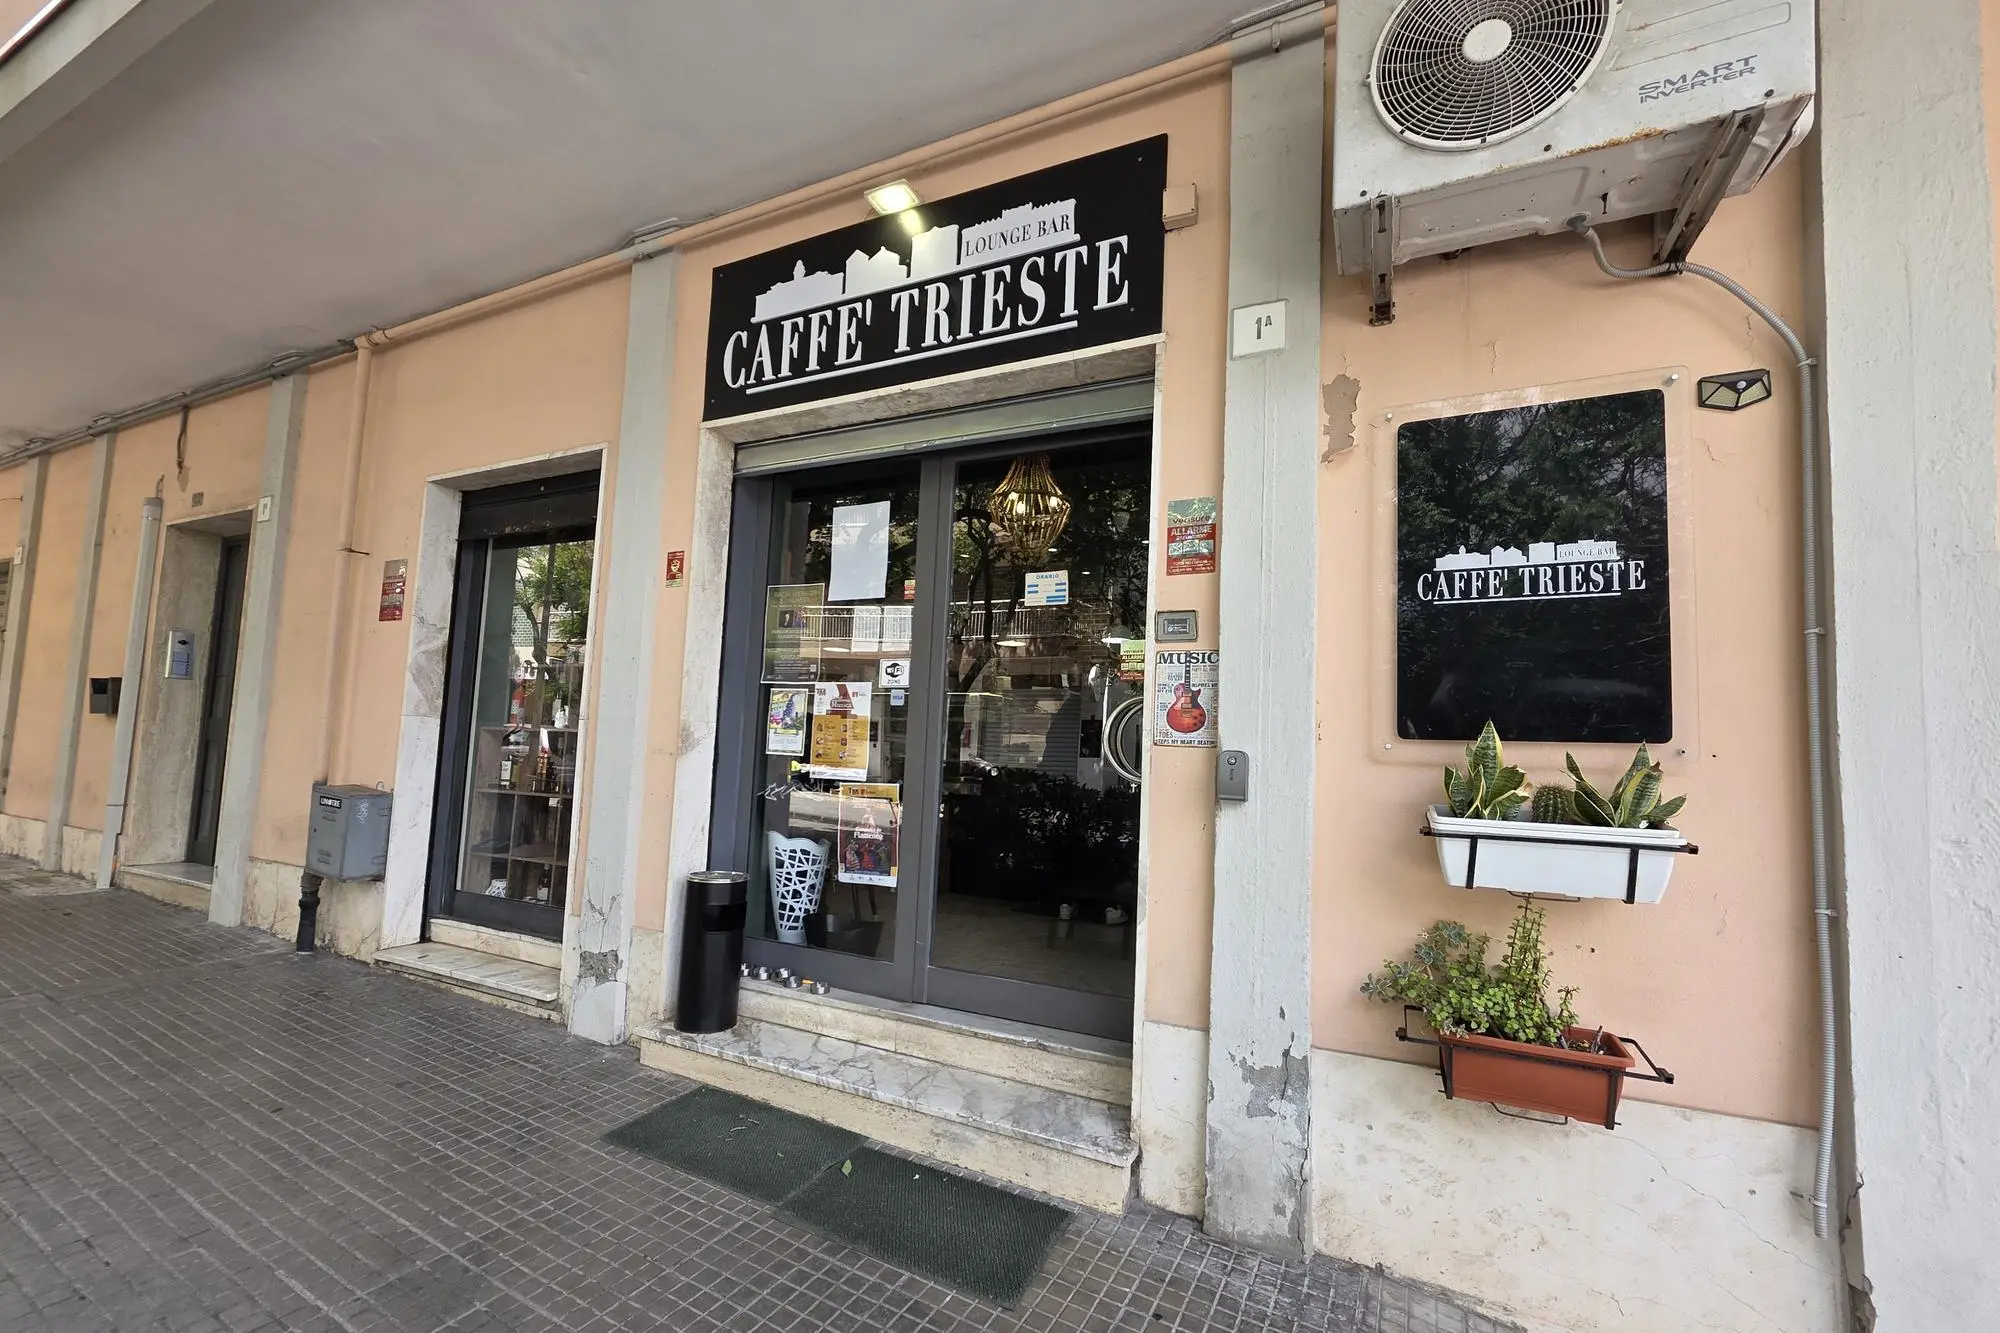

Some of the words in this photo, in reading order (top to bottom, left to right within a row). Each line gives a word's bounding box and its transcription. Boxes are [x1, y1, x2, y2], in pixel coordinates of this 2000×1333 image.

[1638, 54, 1758, 95] SMART
[1640, 66, 1756, 104] INVERTER
[965, 224, 1031, 257] LOUNGE
[1037, 214, 1071, 239] BAR
[723, 298, 872, 389] CAFFE'
[891, 234, 1129, 353] TRIESTE
[1170, 525, 1213, 536] ALLARME
[1559, 549, 1594, 559] LOUNGE
[1597, 547, 1615, 556] BAR
[1417, 569, 1508, 600] CAFFE'
[1518, 560, 1646, 595] TRIESTE
[1157, 652, 1219, 665] MUSIC
